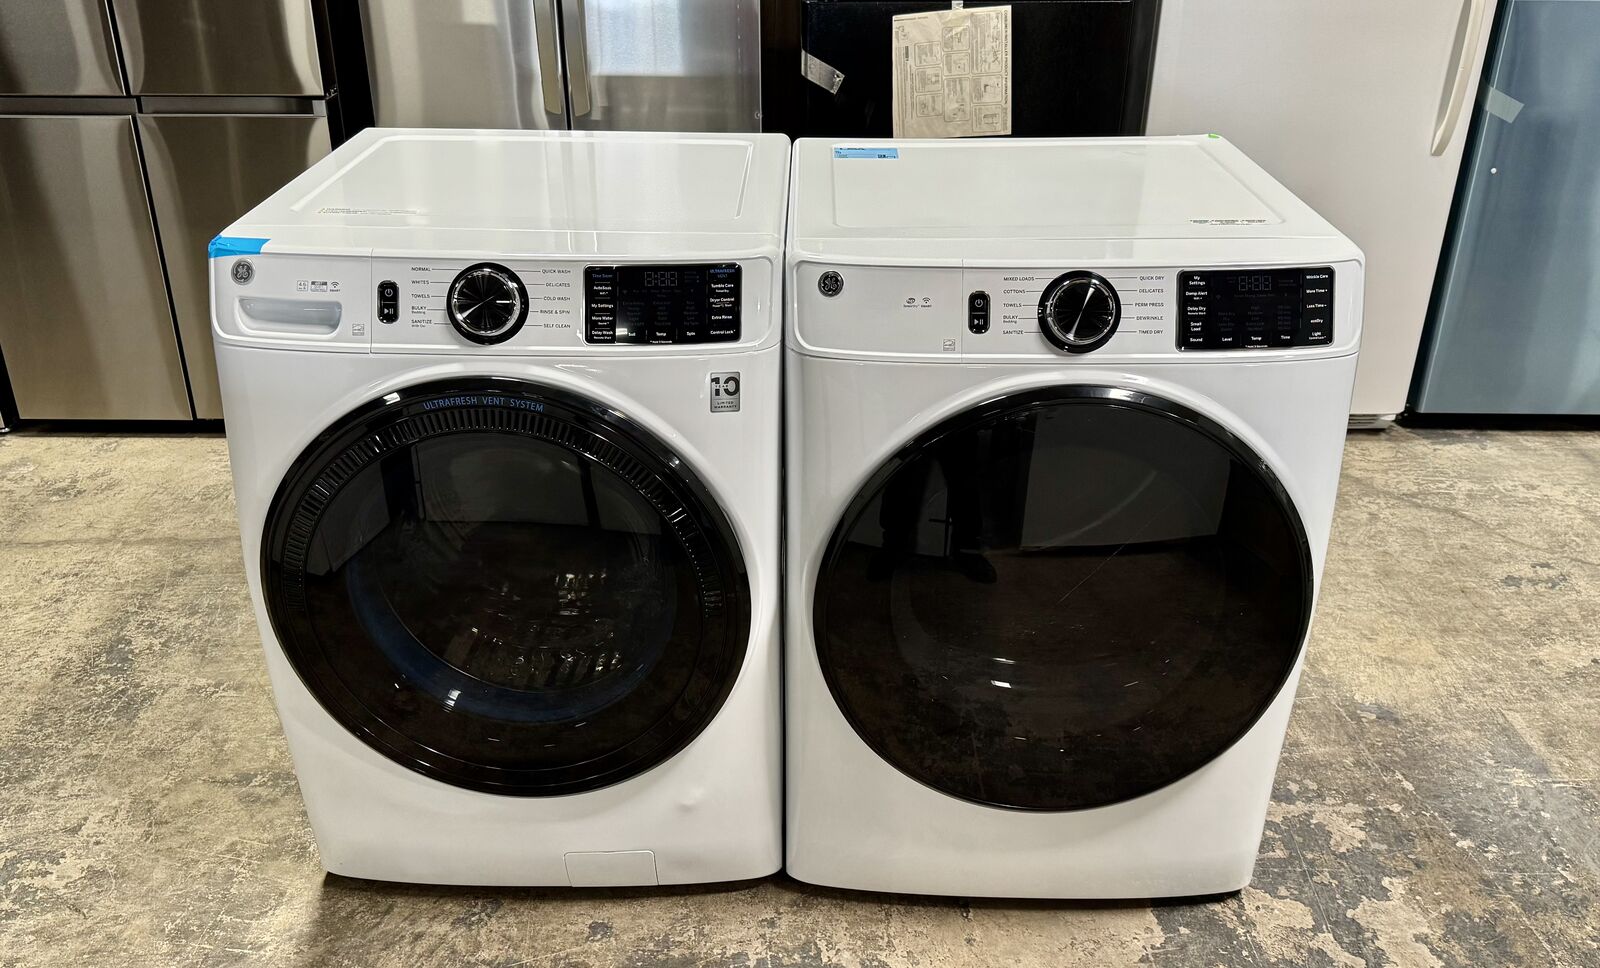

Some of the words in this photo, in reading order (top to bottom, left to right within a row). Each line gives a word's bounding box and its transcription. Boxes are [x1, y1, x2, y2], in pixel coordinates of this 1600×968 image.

[711, 376, 740, 396] 10
[423, 396, 477, 410] ULTRAFRESH
[481, 397, 504, 405] VENT
[510, 398, 544, 412] SYSTEM
